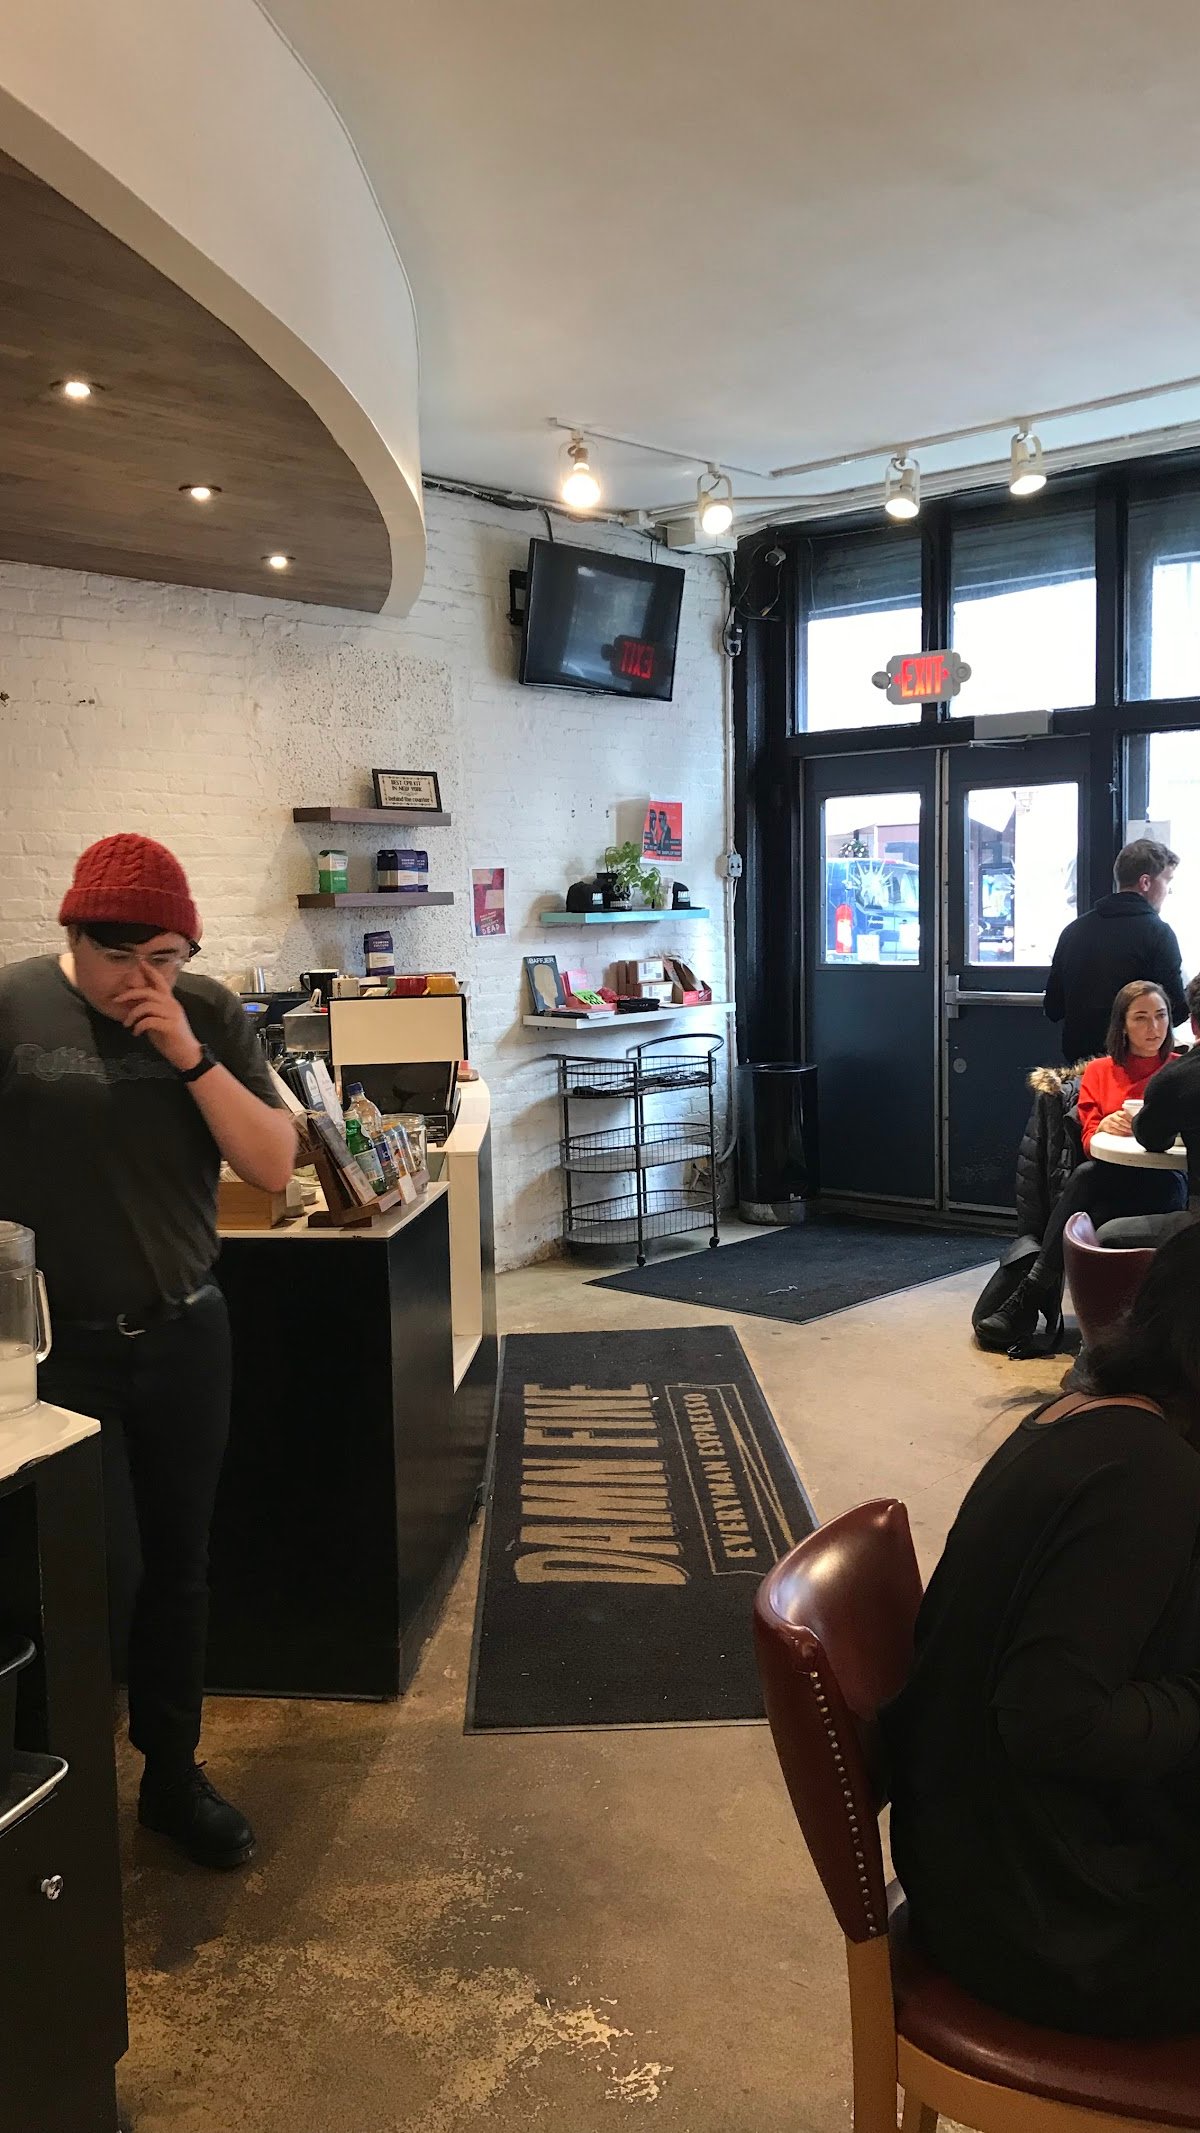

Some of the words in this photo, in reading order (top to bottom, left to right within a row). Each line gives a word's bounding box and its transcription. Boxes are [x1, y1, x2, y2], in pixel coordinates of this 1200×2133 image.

[901, 655, 945, 697] EXIT
[481, 924, 500, 935] DEAD
[523, 1383, 661, 1448] FINE
[682, 1392, 726, 1456] ESPRESSO
[513, 1458, 688, 1585] DAMN
[701, 1460, 758, 1560] EVERYMAN
